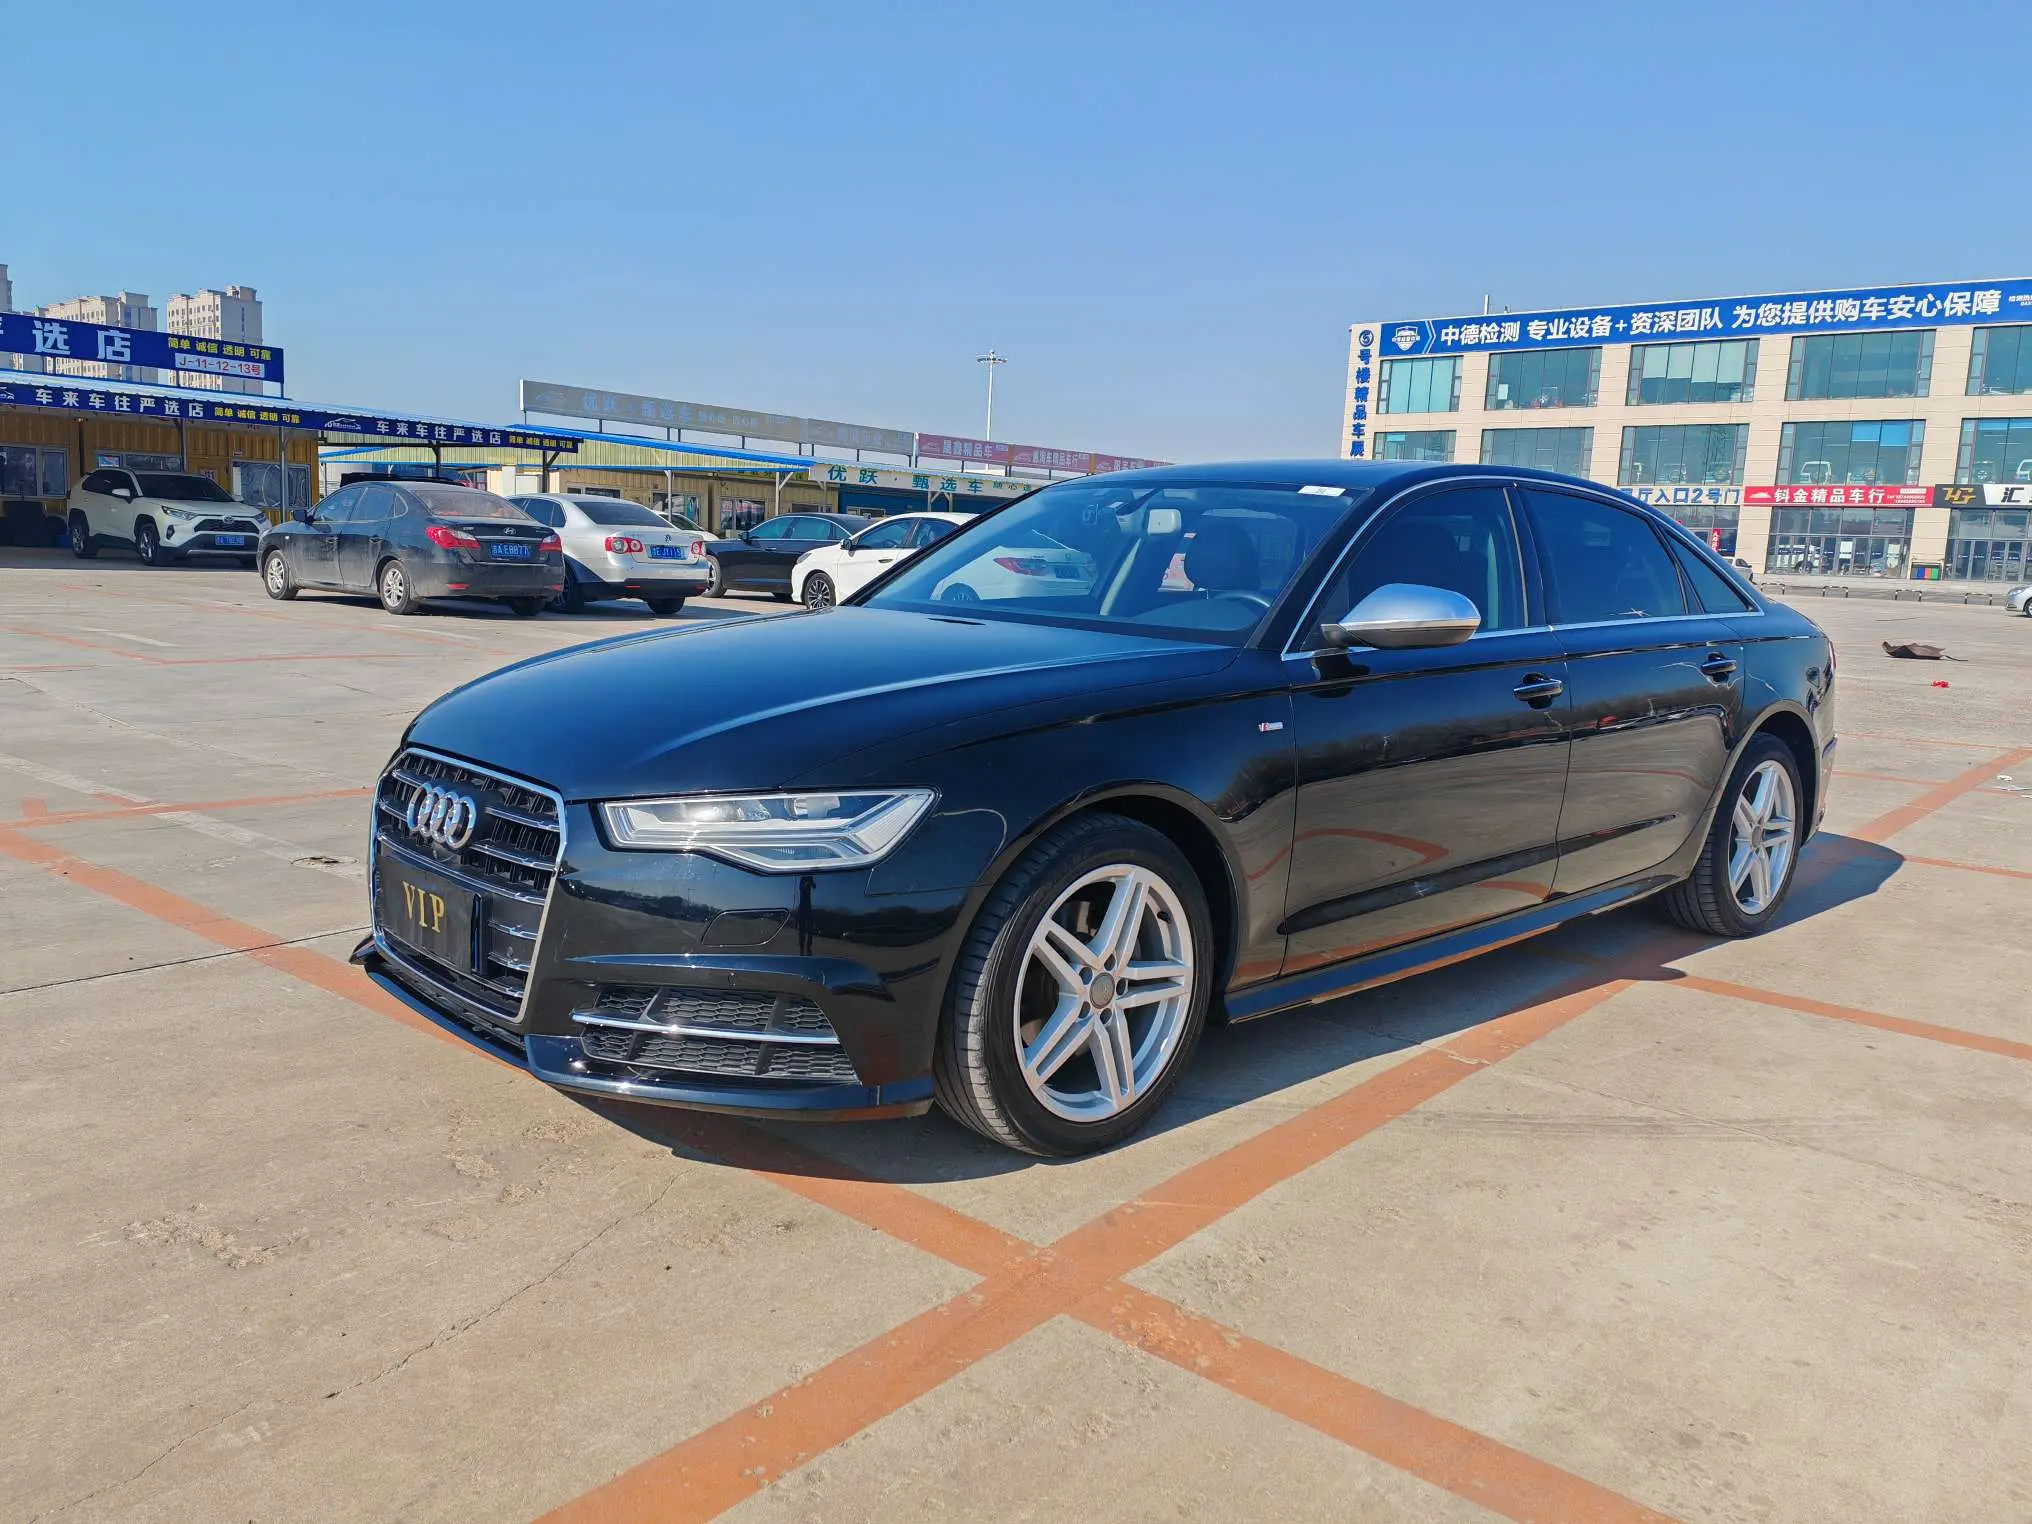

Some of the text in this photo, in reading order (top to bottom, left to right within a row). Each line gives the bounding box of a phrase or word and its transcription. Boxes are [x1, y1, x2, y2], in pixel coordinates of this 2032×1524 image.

[1439, 320, 1520, 346] 中德检测
[1527, 307, 1723, 342] 专业设备+资深团队
[1732, 289, 2001, 329] 为您提供购车安心保障
[0, 317, 131, 362] 选店
[168, 336, 272, 361] 简单 诚信 透明 可靠
[179, 355, 261, 376] J-11-12-13号
[36, 388, 204, 418] 车来车往严选店
[376, 419, 501, 445] 车来车往严选店
[403, 880, 445, 933] VIP
